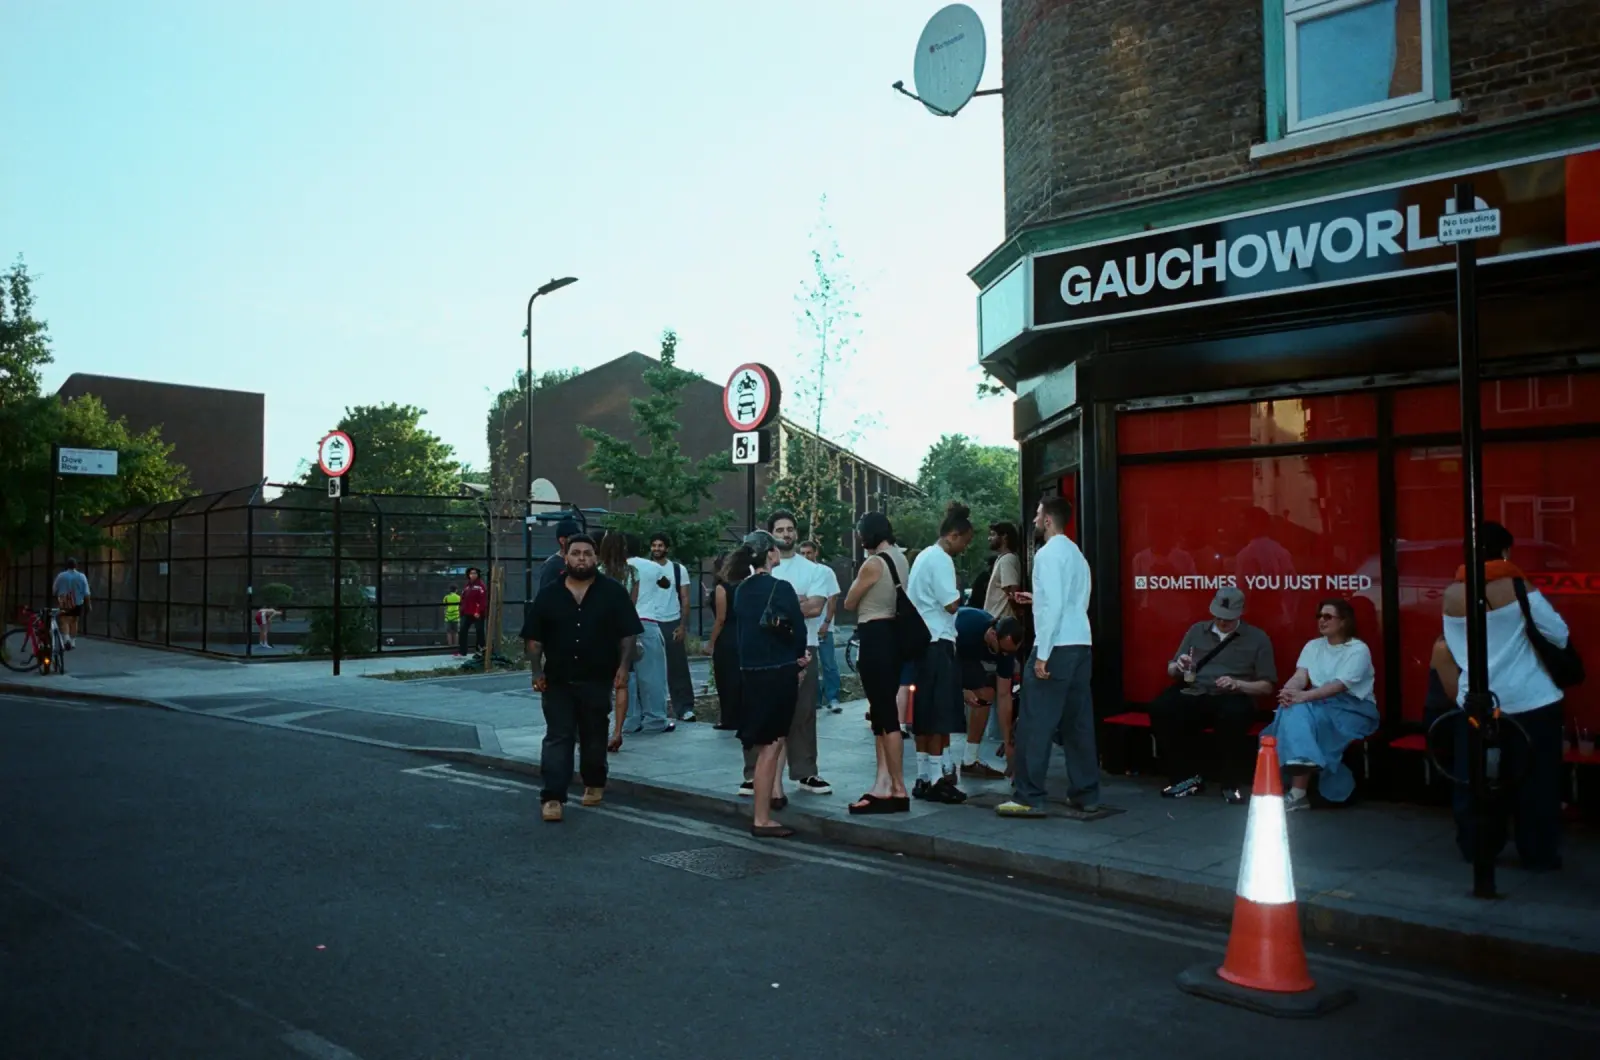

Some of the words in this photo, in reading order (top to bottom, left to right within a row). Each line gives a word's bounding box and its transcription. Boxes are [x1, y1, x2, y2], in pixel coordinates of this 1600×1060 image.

[1443, 219, 1457, 227] No
[1460, 214, 1497, 225] loading
[1443, 229, 1453, 237] at
[1456, 227, 1472, 236] any
[1475, 224, 1497, 233] time
[1059, 195, 1490, 305] GAUCHOWORL
[61, 455, 83, 464] Dove
[1150, 575, 1237, 590] SOMETIMES
[1245, 575, 1280, 590] YOU
[1284, 575, 1322, 590] JUST
[1326, 575, 1372, 590] NEED
